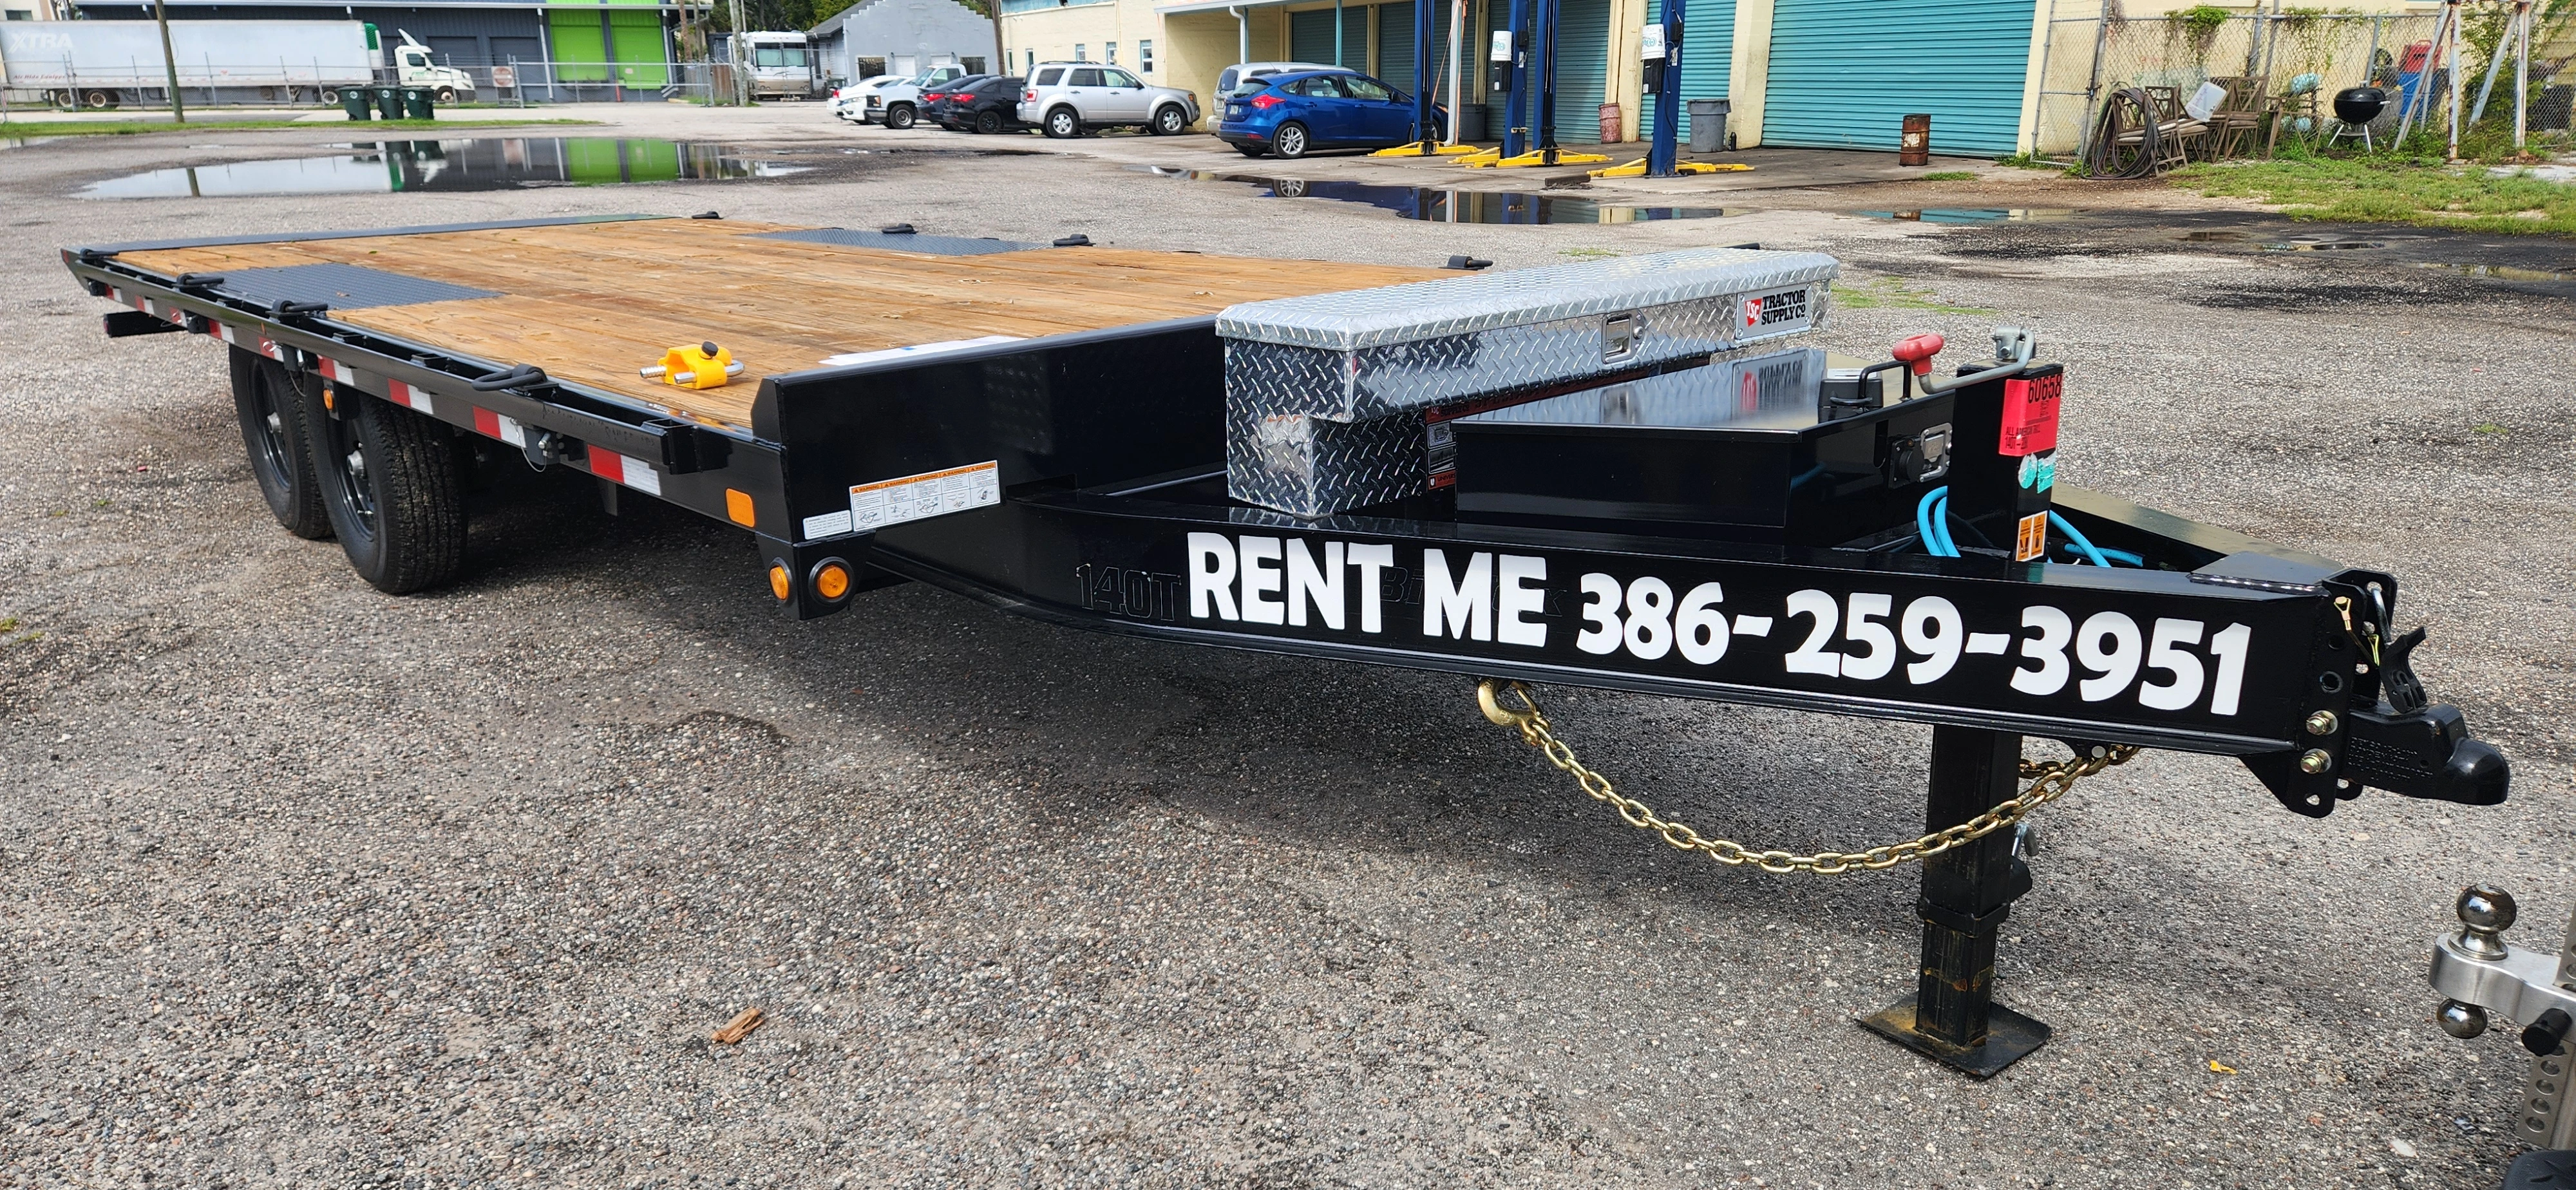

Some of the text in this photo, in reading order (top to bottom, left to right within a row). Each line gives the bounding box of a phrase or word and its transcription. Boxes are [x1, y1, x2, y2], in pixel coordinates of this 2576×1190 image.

[7, 32, 73, 53] XTRA
[1762, 289, 1806, 310] TRACTOR
[1746, 301, 1759, 321] TSC
[1761, 306, 1796, 325] SUPPLY
[2028, 374, 2061, 404] 60658
[2005, 426, 2014, 435] ALL
[1437, 473, 1455, 482] UNIVERS
[1075, 562, 1182, 621] 140T
[1187, 532, 1394, 633] RENT
[1423, 548, 1548, 648] ME
[1576, 572, 2251, 716] 386-259-3951
